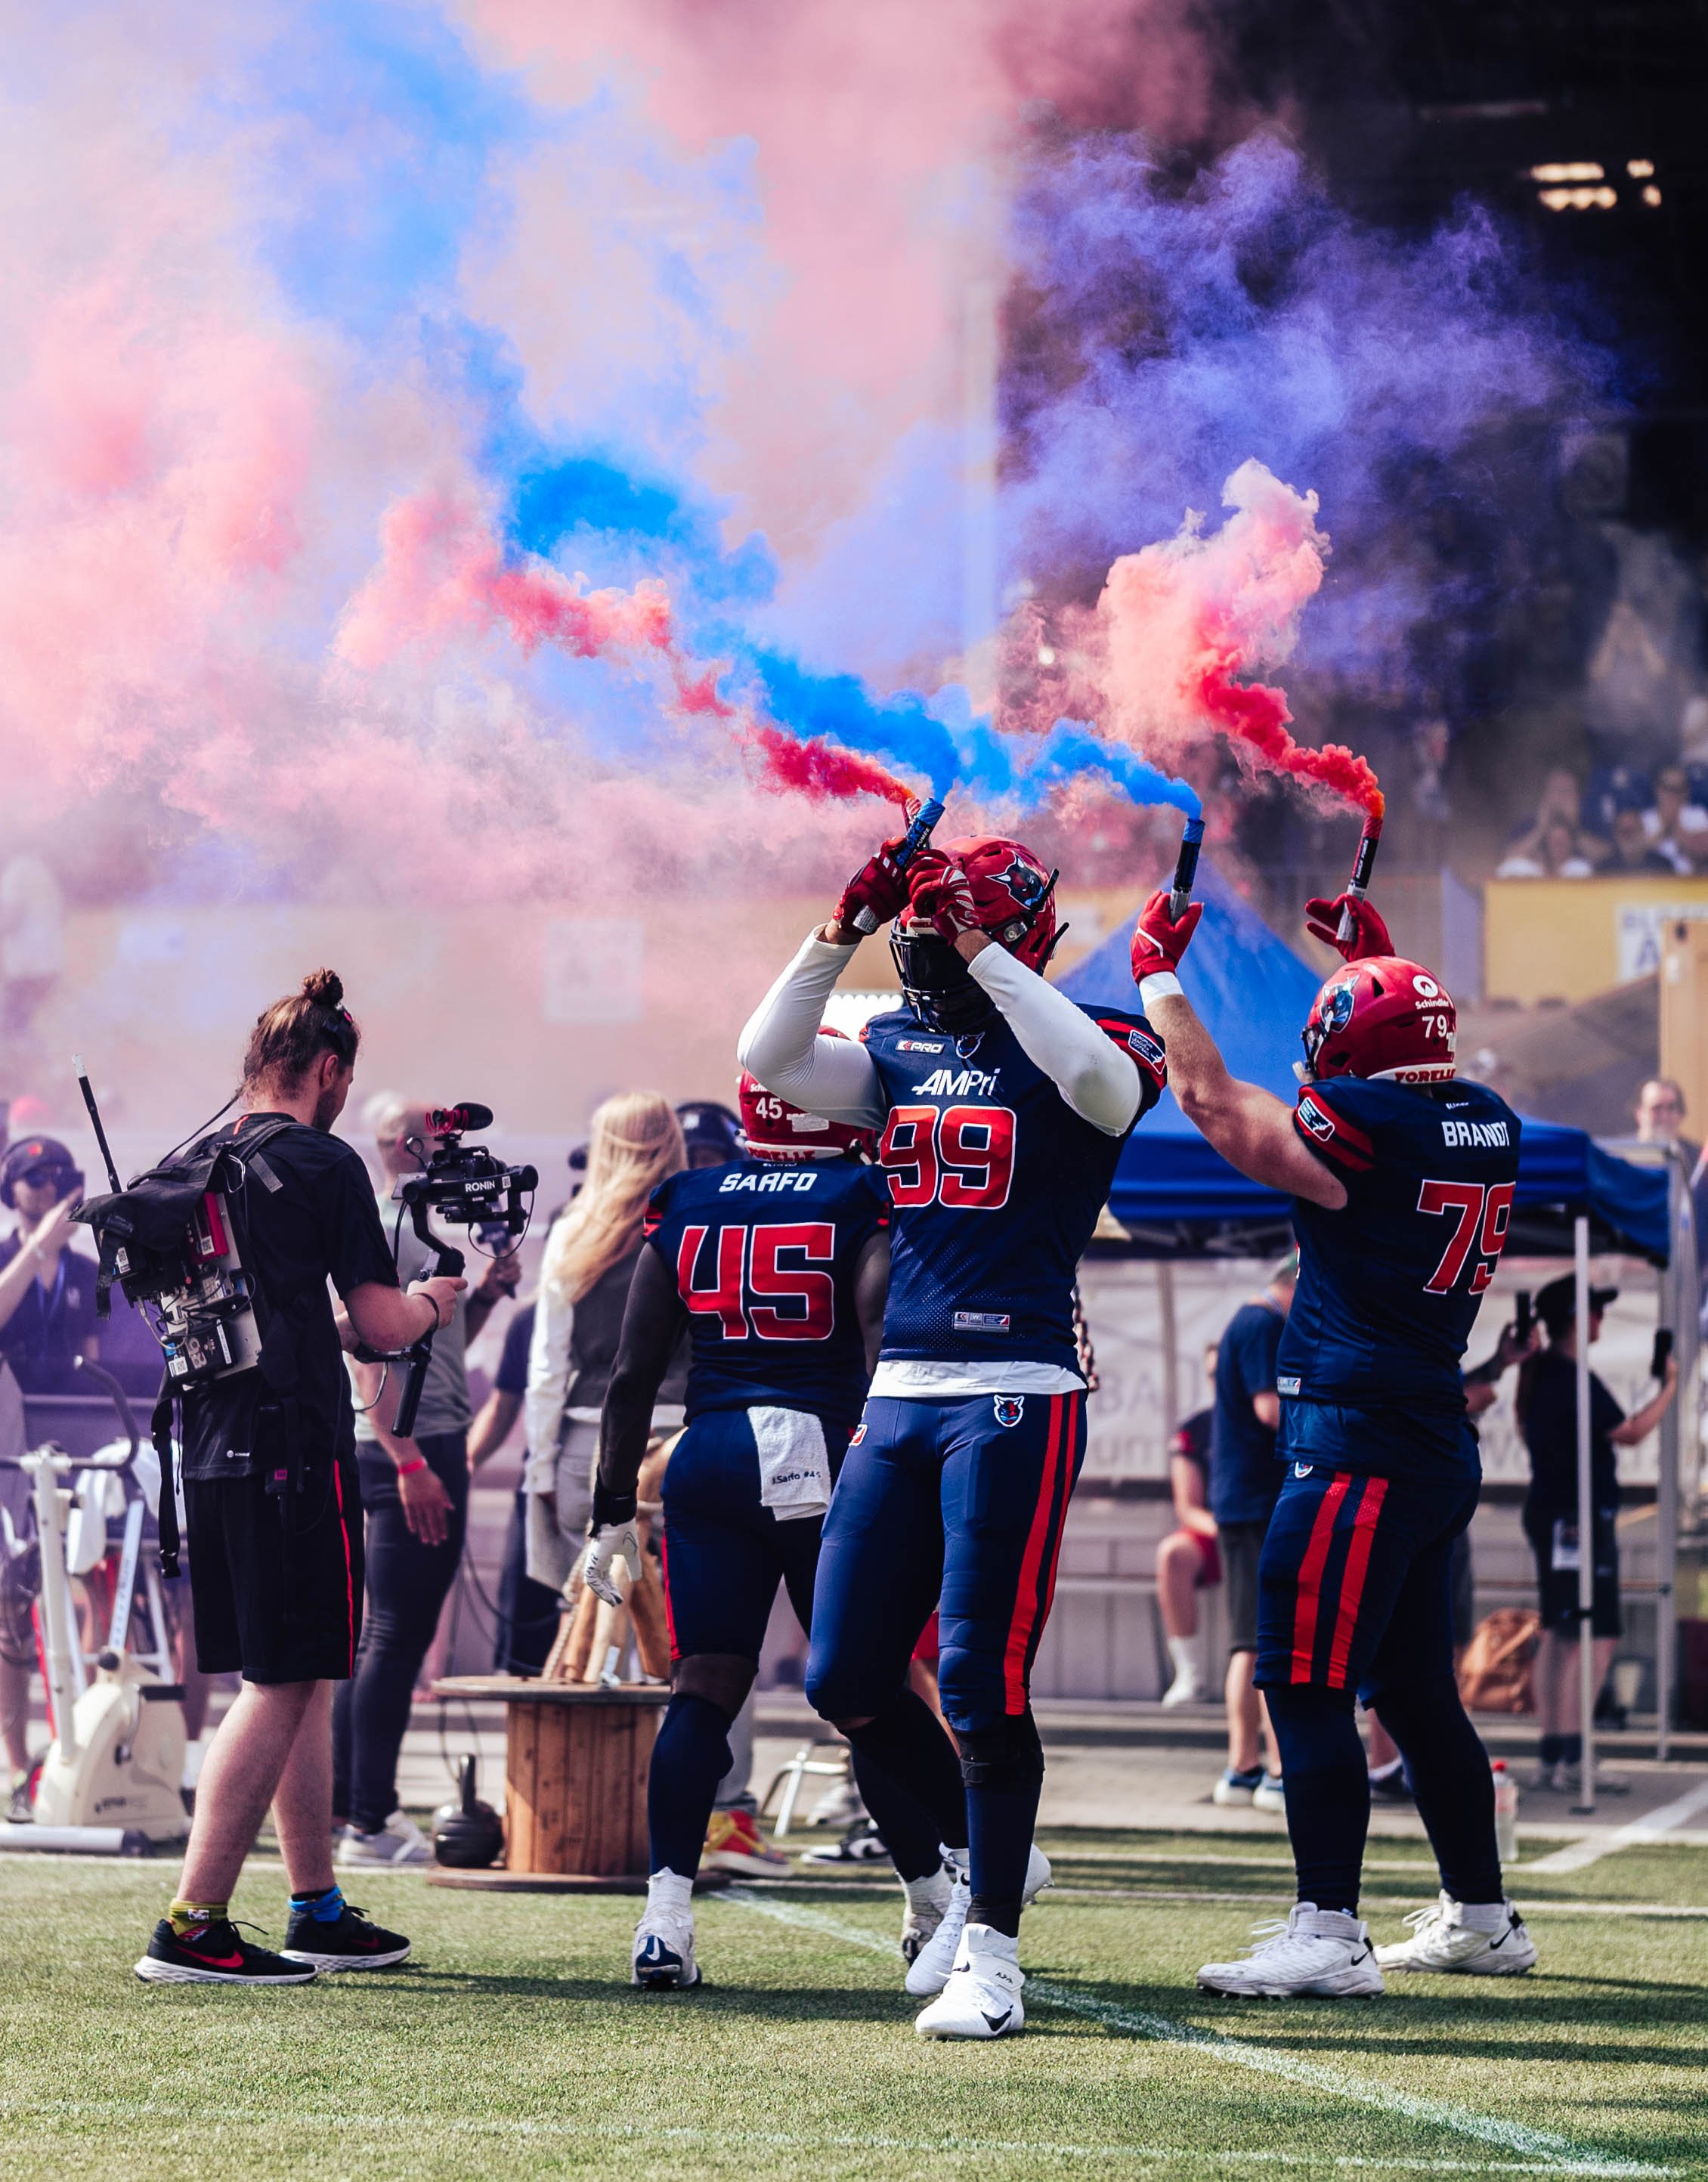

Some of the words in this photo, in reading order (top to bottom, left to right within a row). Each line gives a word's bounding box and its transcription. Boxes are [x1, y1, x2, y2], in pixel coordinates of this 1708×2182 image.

[1415, 998, 1450, 1010] Schindler
[1422, 1014, 1448, 1038] 79
[911, 1068, 1001, 1096] AMPri
[756, 1097, 783, 1119] 45
[880, 1104, 1016, 1209] 99
[465, 1181, 496, 1193] RONIN
[719, 1172, 818, 1192] SARFO
[1416, 1179, 1516, 1295] 79
[677, 1221, 835, 1341] 45
